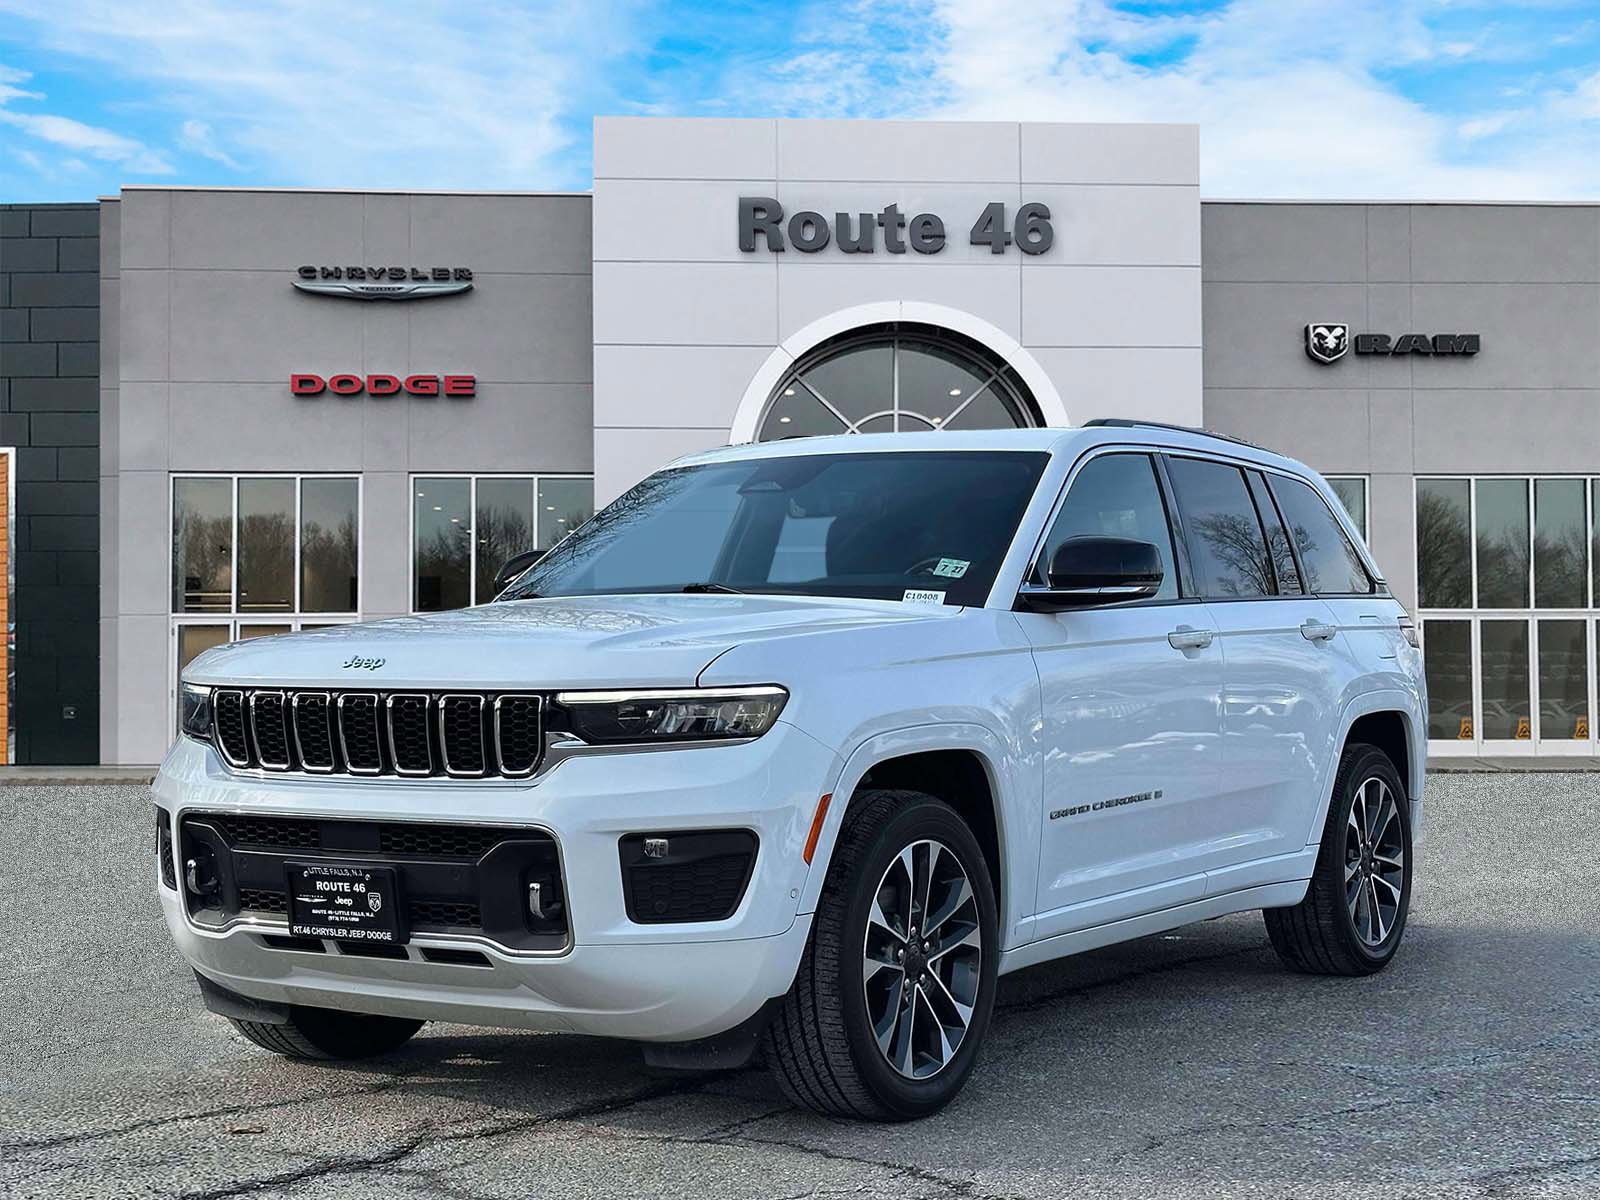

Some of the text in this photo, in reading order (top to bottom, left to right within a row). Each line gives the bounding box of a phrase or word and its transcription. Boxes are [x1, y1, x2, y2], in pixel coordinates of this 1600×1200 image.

[738, 196, 1055, 256] Route 46
[298, 265, 473, 282] CHRYSLER
[1354, 333, 1480, 356] RAM
[291, 374, 476, 397] DODGE
[342, 655, 386, 671] Jeep
[1049, 791, 1152, 820] GRAND CHEROKEE
[307, 867, 329, 876] LITTLE
[315, 881, 366, 893] ROUTE 46
[334, 896, 353, 906] Jeep
[311, 927, 347, 937] CHRYSLER
[348, 929, 366, 939] JEEP
[366, 931, 392, 940] DODGE
